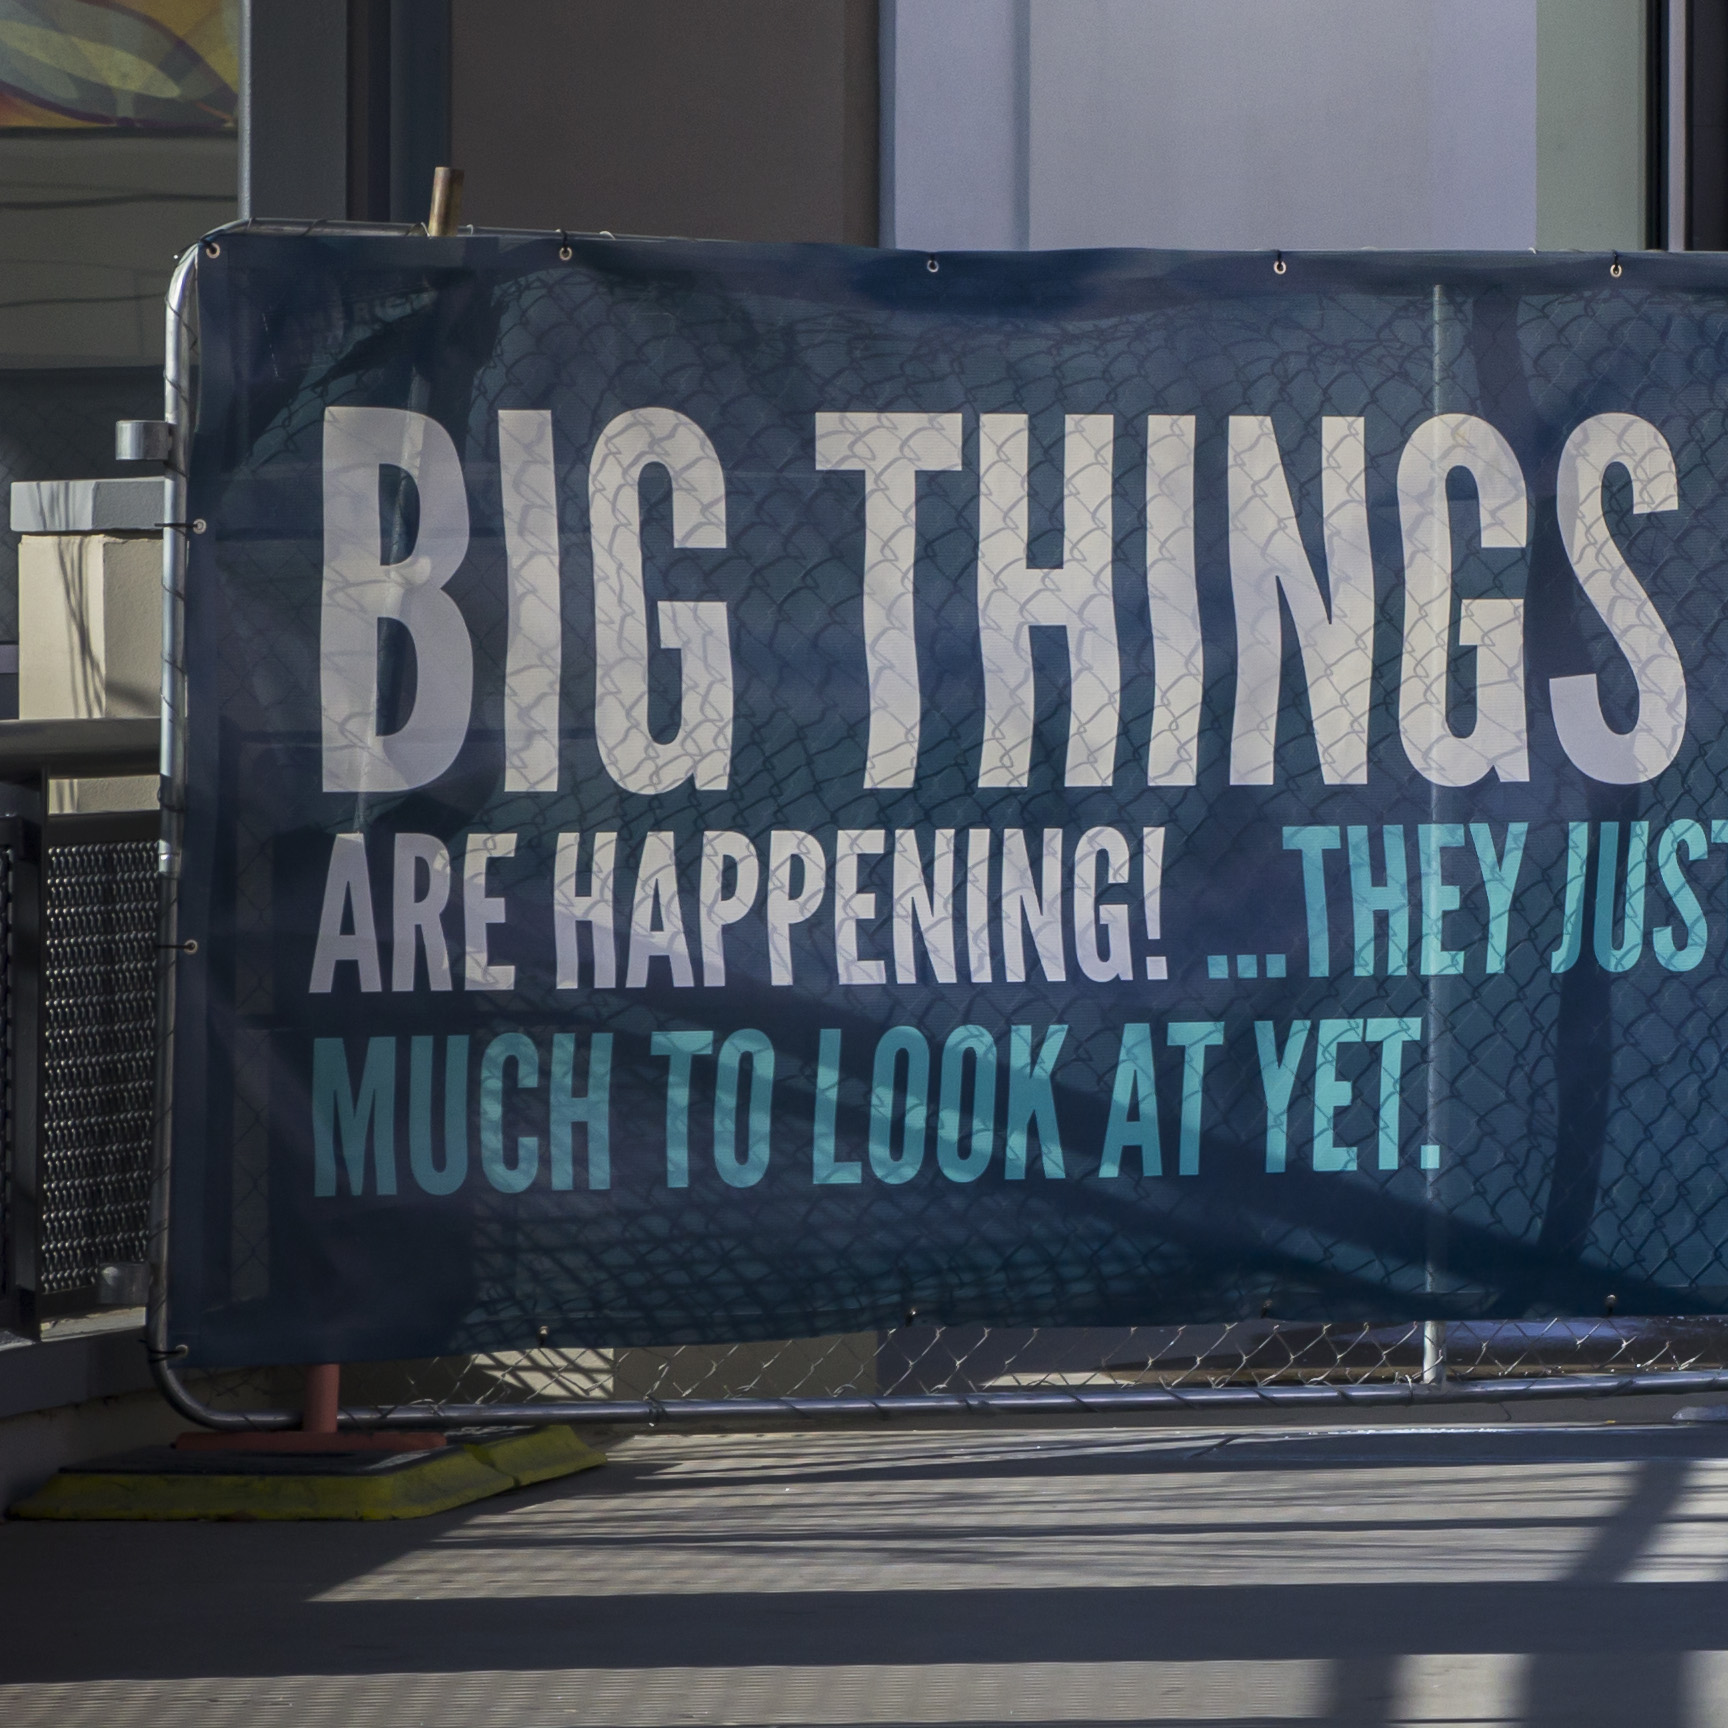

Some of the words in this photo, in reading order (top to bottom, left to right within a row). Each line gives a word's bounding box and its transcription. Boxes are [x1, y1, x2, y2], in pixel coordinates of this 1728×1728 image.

[319, 406, 735, 795] BIG
[814, 410, 1688, 790] THINGS
[308, 831, 517, 994] ARE
[553, 826, 1169, 990] HAPPENING!
[311, 1032, 613, 1198] MUCH
[651, 1027, 775, 1188] TO
[811, 1023, 1069, 1185] LOOK
[1097, 1020, 1225, 1180] AT
[1254, 1017, 1440, 1174] YET.
